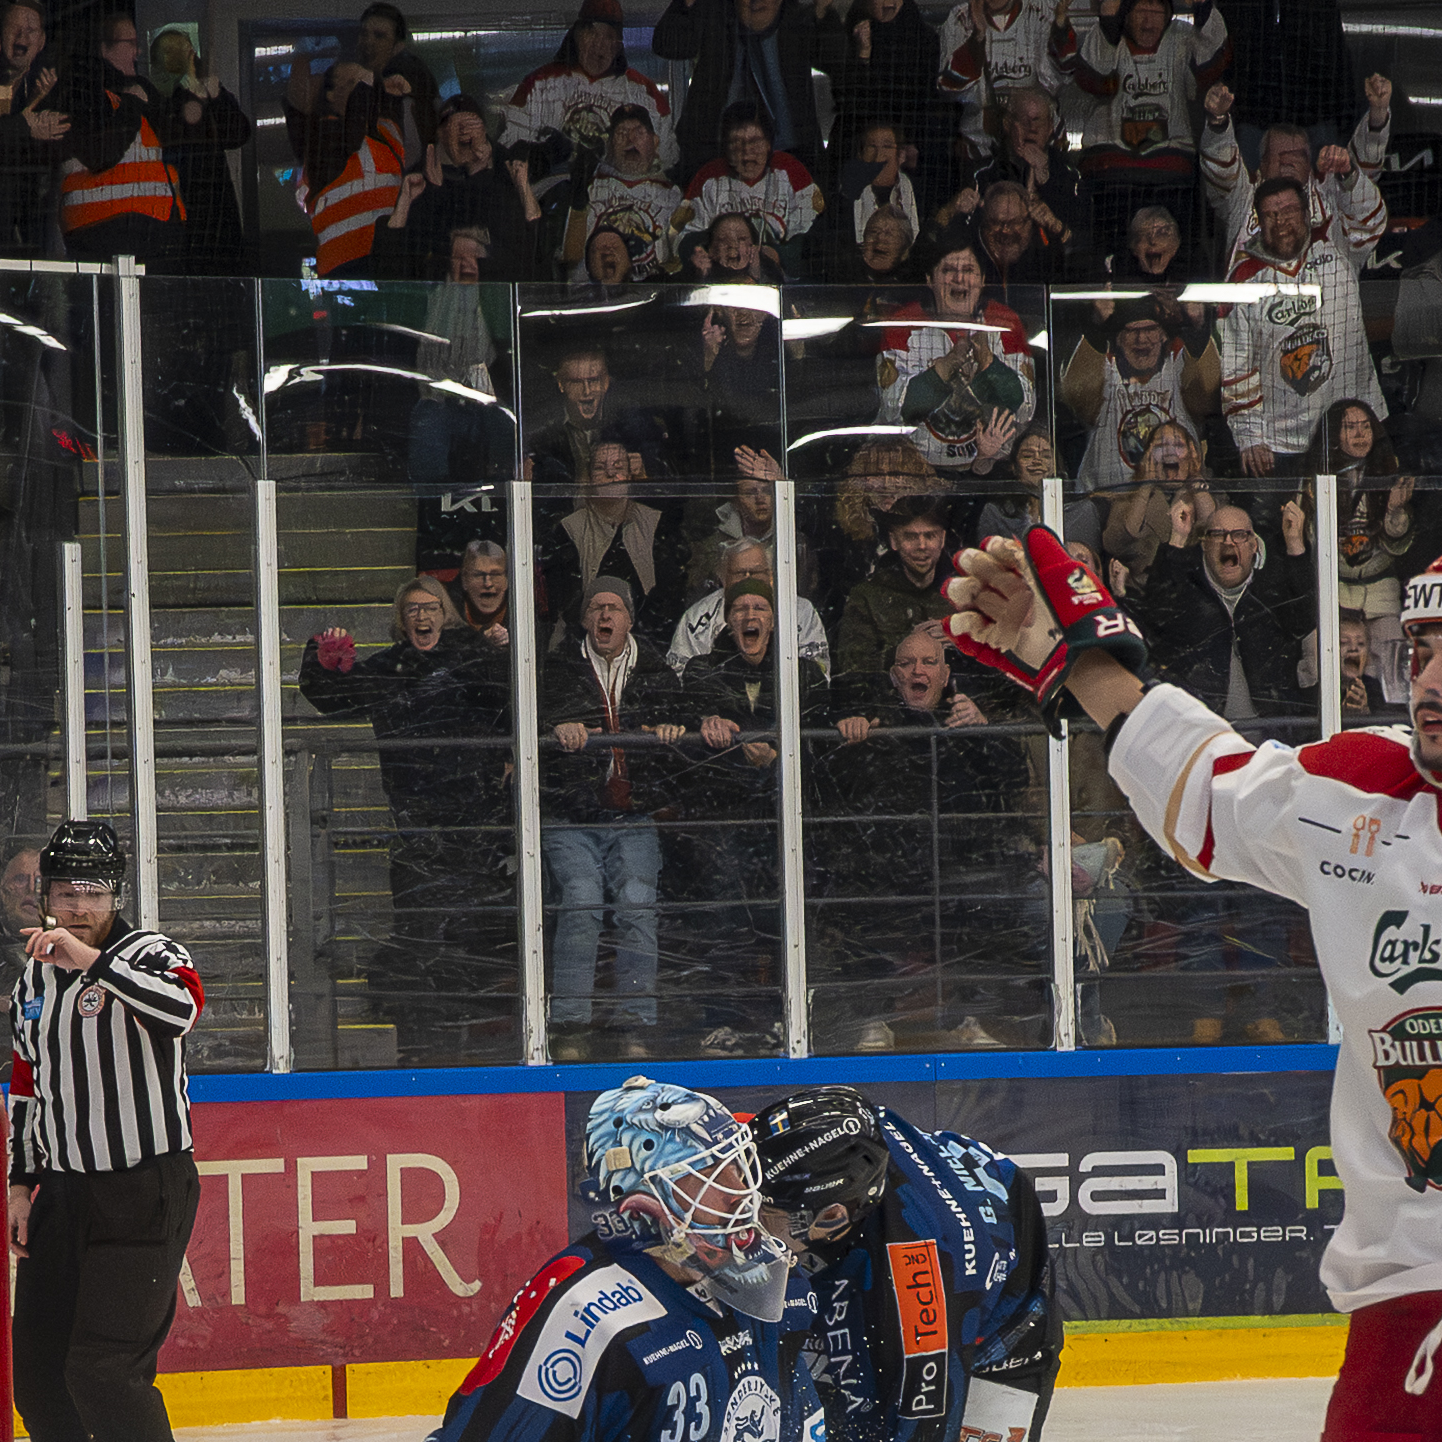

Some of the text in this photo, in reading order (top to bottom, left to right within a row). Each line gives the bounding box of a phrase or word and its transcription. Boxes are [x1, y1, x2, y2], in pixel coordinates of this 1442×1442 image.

[764, 1127, 846, 1180] KUEHNE+NAGEL
[564, 1280, 644, 1349] Lindab
[906, 1270, 939, 1412] Pro Tech
